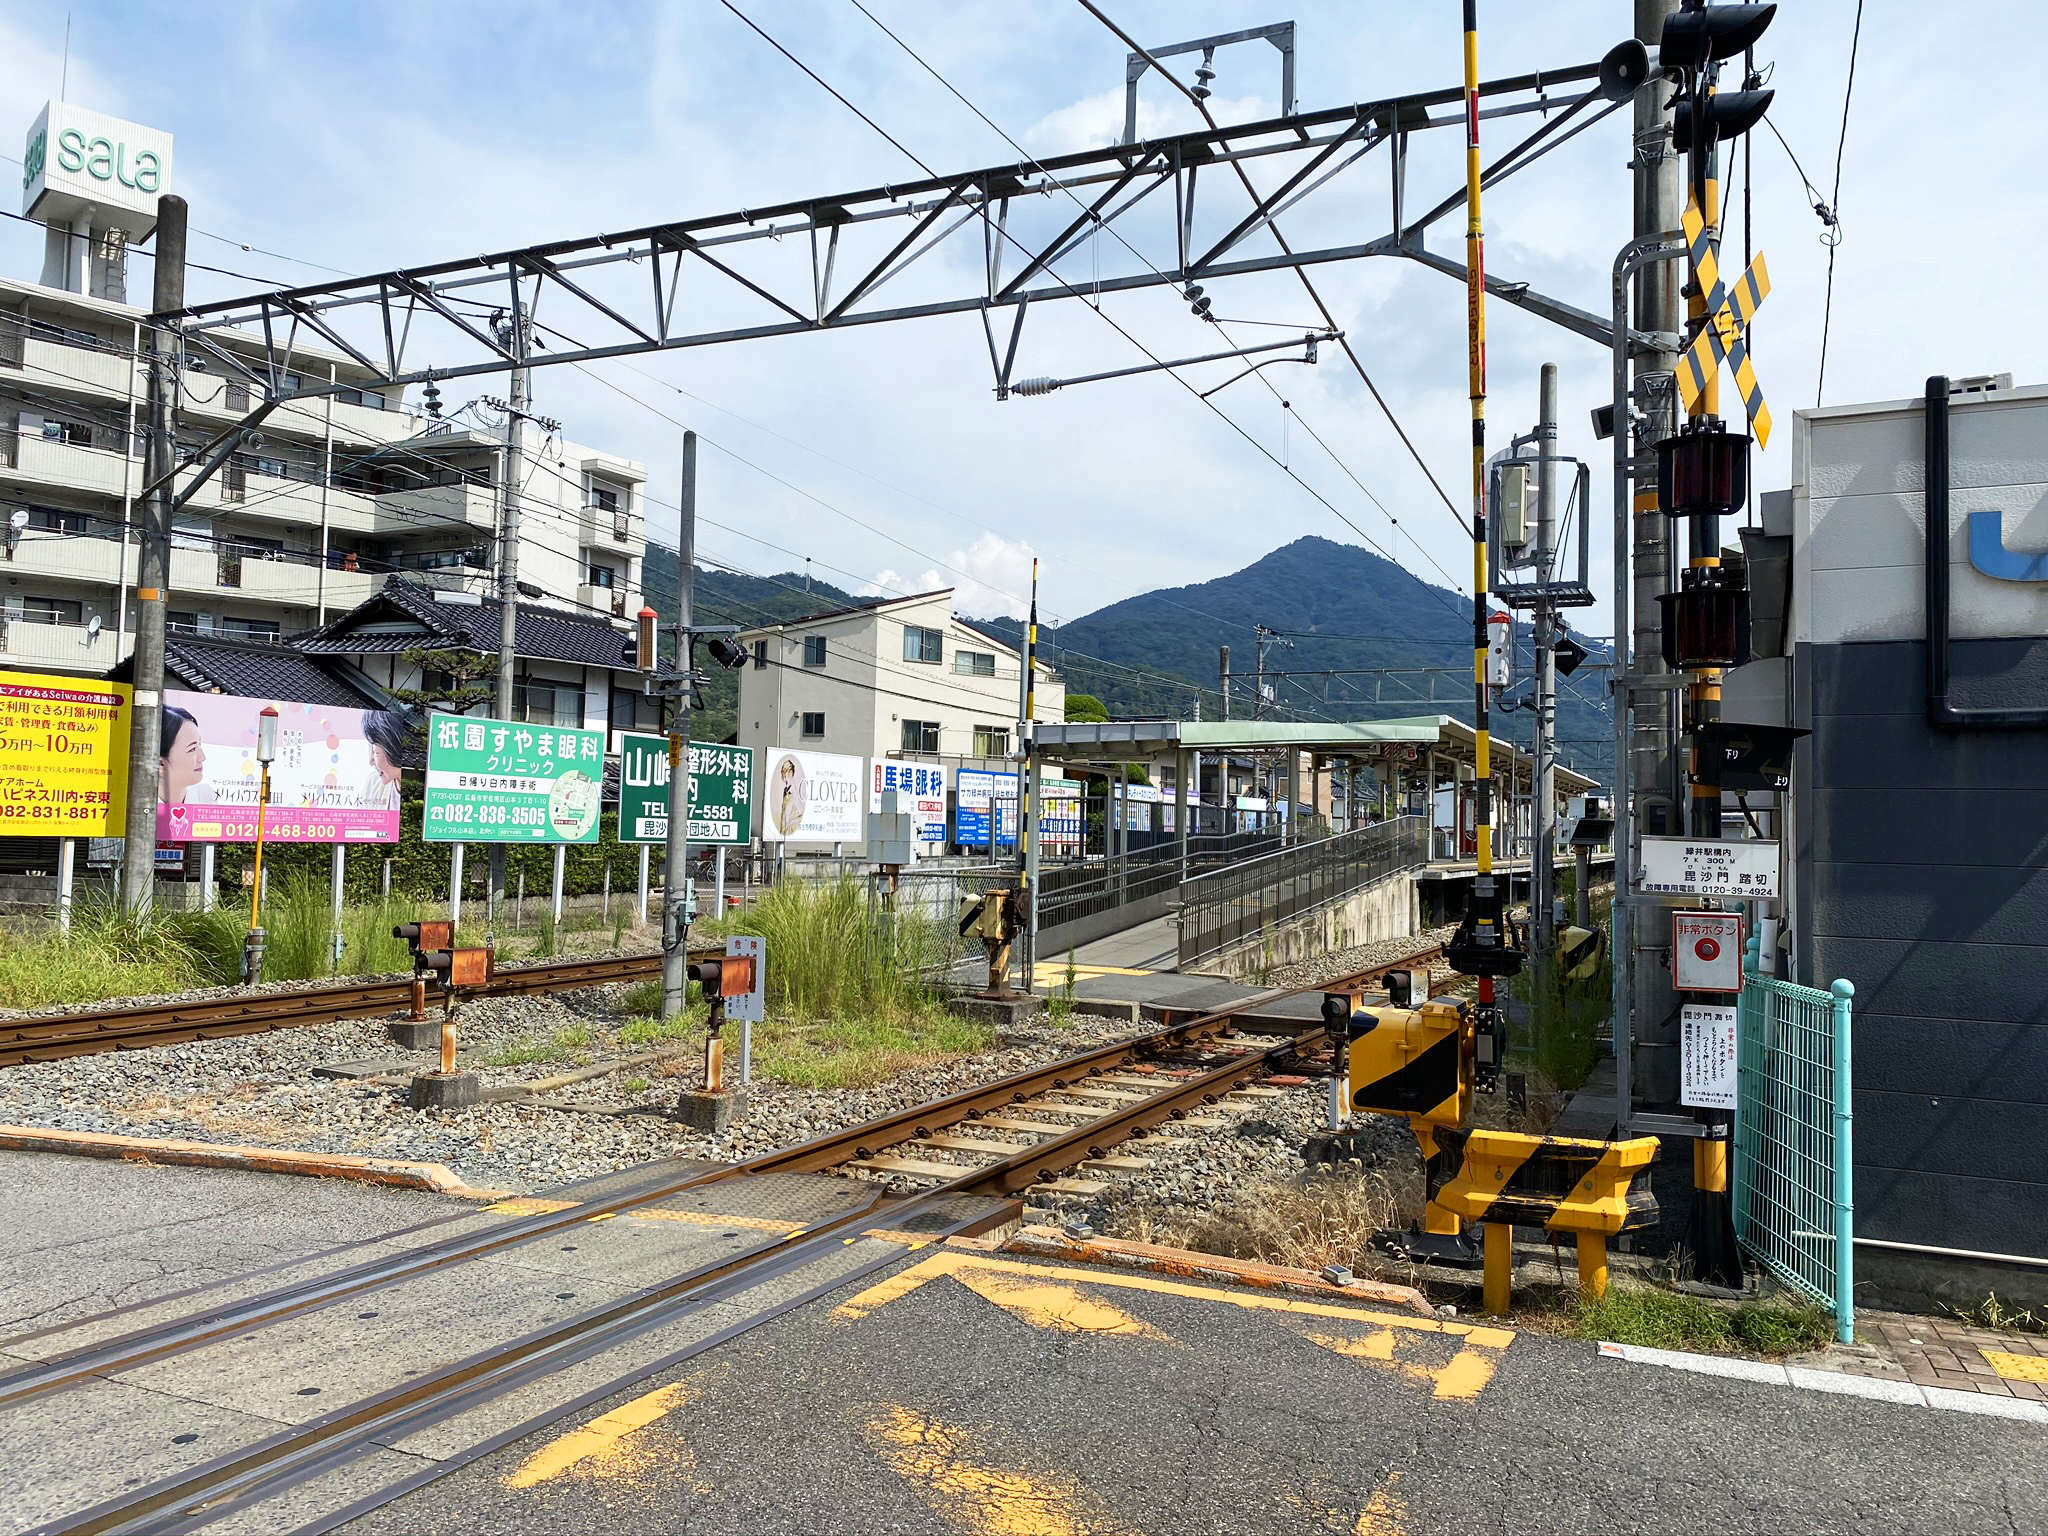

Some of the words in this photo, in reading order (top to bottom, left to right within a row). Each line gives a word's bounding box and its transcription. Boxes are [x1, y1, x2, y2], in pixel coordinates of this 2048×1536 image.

[58, 127, 162, 193] sala
[437, 720, 598, 763] 祇園すやま眼科
[1725, 748, 1739, 760] 下り
[487, 755, 554, 776] クリニック
[459, 776, 536, 791] 日帰り白内障手術
[884, 766, 943, 797] 馬場眼科
[1774, 775, 1788, 787] 上り
[798, 780, 858, 802] CLOVER
[445, 803, 546, 825] 082-836-3505
[644, 821, 731, 837] 毘沙団地入口
[1685, 847, 1732, 857] 緑井駅構内
[1684, 870, 1729, 883] 毘沙門
[1739, 873, 1768, 886] 踏切
[1645, 883, 1696, 893] 故障専用電話
[1702, 885, 1773, 896] 0120-39-4924
